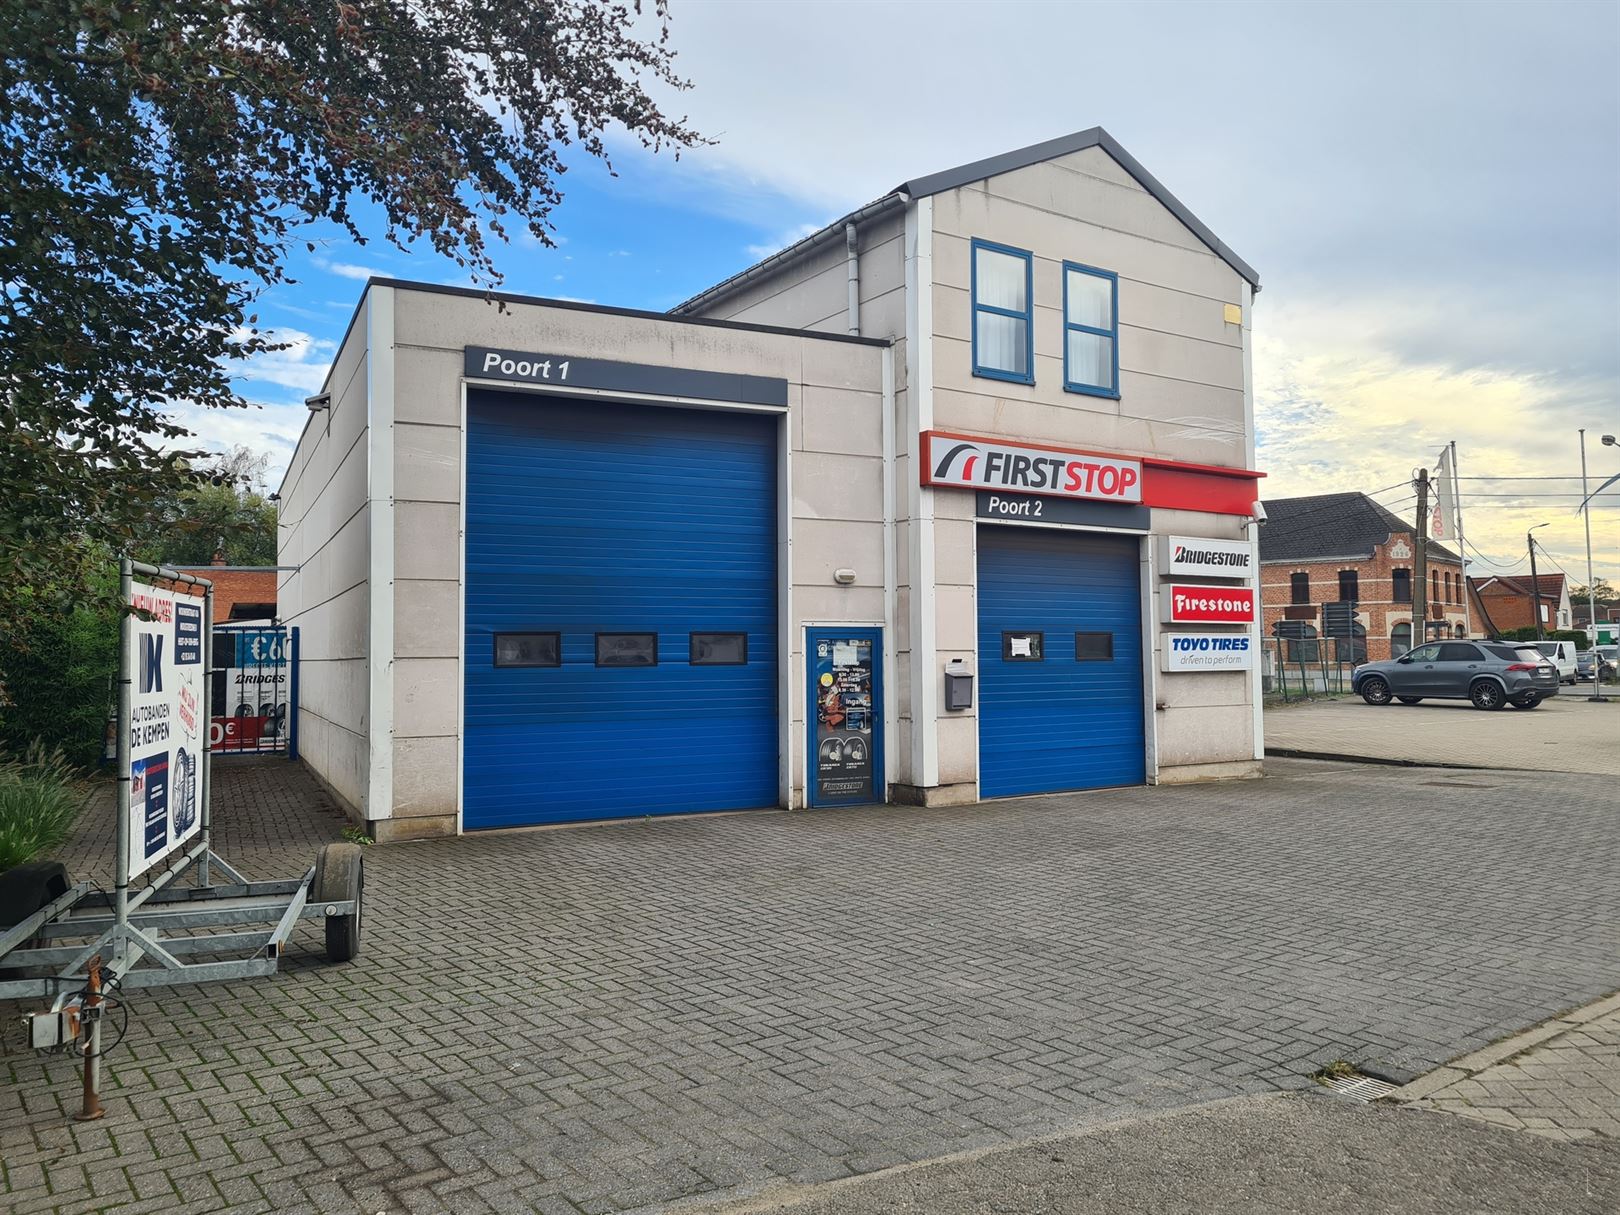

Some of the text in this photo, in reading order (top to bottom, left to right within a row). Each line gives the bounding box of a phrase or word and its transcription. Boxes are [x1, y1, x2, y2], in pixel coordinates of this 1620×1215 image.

[483, 352, 570, 380] Poort 1
[989, 496, 1043, 517] Poort 2
[1174, 546, 1250, 567] BRIDGESTONE
[1175, 594, 1251, 613] Firestone
[1172, 638, 1249, 651] TOYO TIRES
[1180, 654, 1204, 665] driven
[1213, 654, 1242, 667] perform
[235, 674, 286, 685] BRIDGES
[132, 703, 170, 723] AUTOBANDEN
[132, 721, 170, 748] DE KEMPEN
